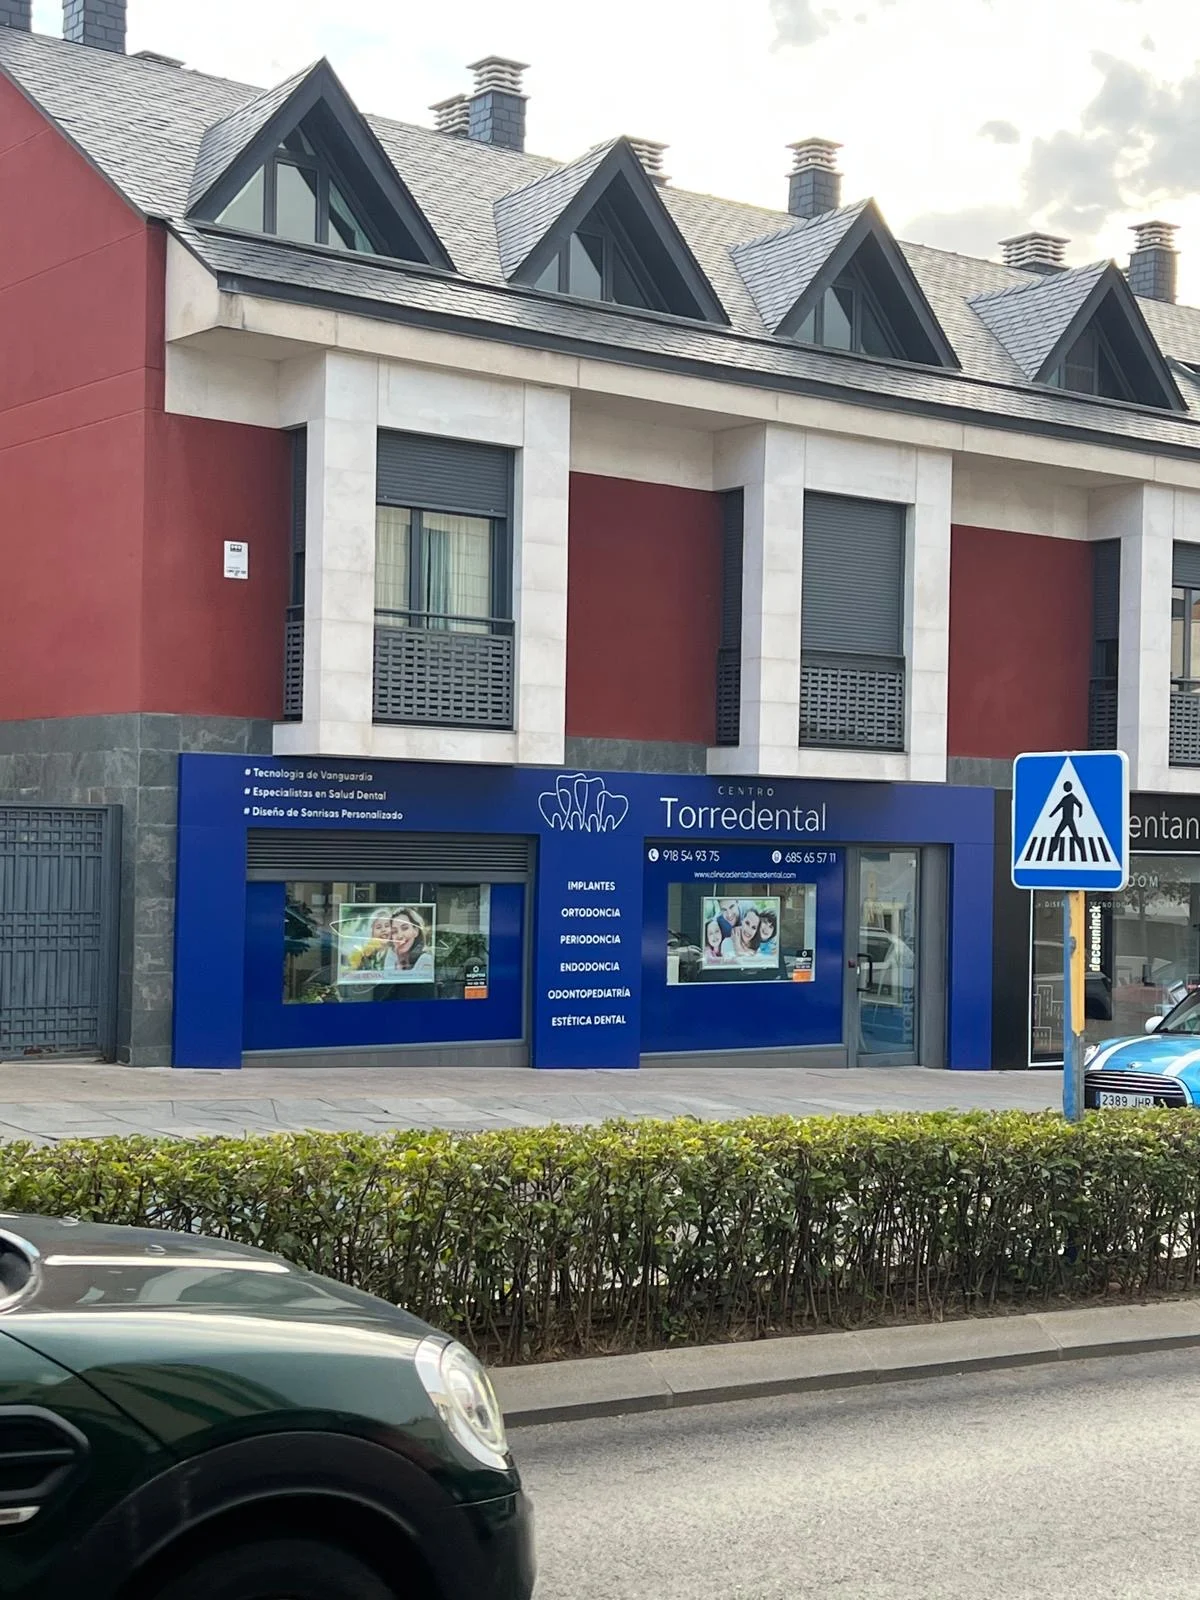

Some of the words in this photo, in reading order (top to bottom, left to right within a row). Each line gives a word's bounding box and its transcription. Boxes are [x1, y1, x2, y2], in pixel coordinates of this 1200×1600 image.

[306, 770, 318, 779] de
[320, 770, 373, 783] Vanguardia
[253, 787, 313, 799] Especialistas
[315, 790, 326, 798] en
[328, 789, 354, 800] Salud
[357, 790, 387, 801] Dental
[718, 786, 775, 797] CENTRO
[252, 806, 285, 817] Diseño
[287, 807, 299, 817] de
[301, 807, 340, 818] Sonrisas
[341, 809, 403, 820] Personalizado
[659, 797, 826, 832] Torredental
[662, 849, 678, 862] 918
[681, 849, 693, 862] 54
[695, 850, 707, 862] 93
[709, 850, 720, 862] 75
[784, 851, 802, 864] 685
[804, 852, 815, 864] 65
[816, 852, 827, 864] 57
[829, 852, 837, 864] 11
[567, 881, 616, 891] IMPLANTES
[561, 908, 621, 918] ORTODONCIA
[560, 934, 621, 945] PERIODONCIA
[1089, 905, 1102, 972] deceuninck
[560, 961, 620, 972] ENDODONCIA
[547, 986, 631, 1000] ODONTOPEDIATRÍA
[551, 1014, 592, 1027] ESTÉTICA
[593, 1014, 627, 1025] DENTAL
[1102, 1094, 1128, 1107] 2389
[1131, 1096, 1151, 1108] JHR
